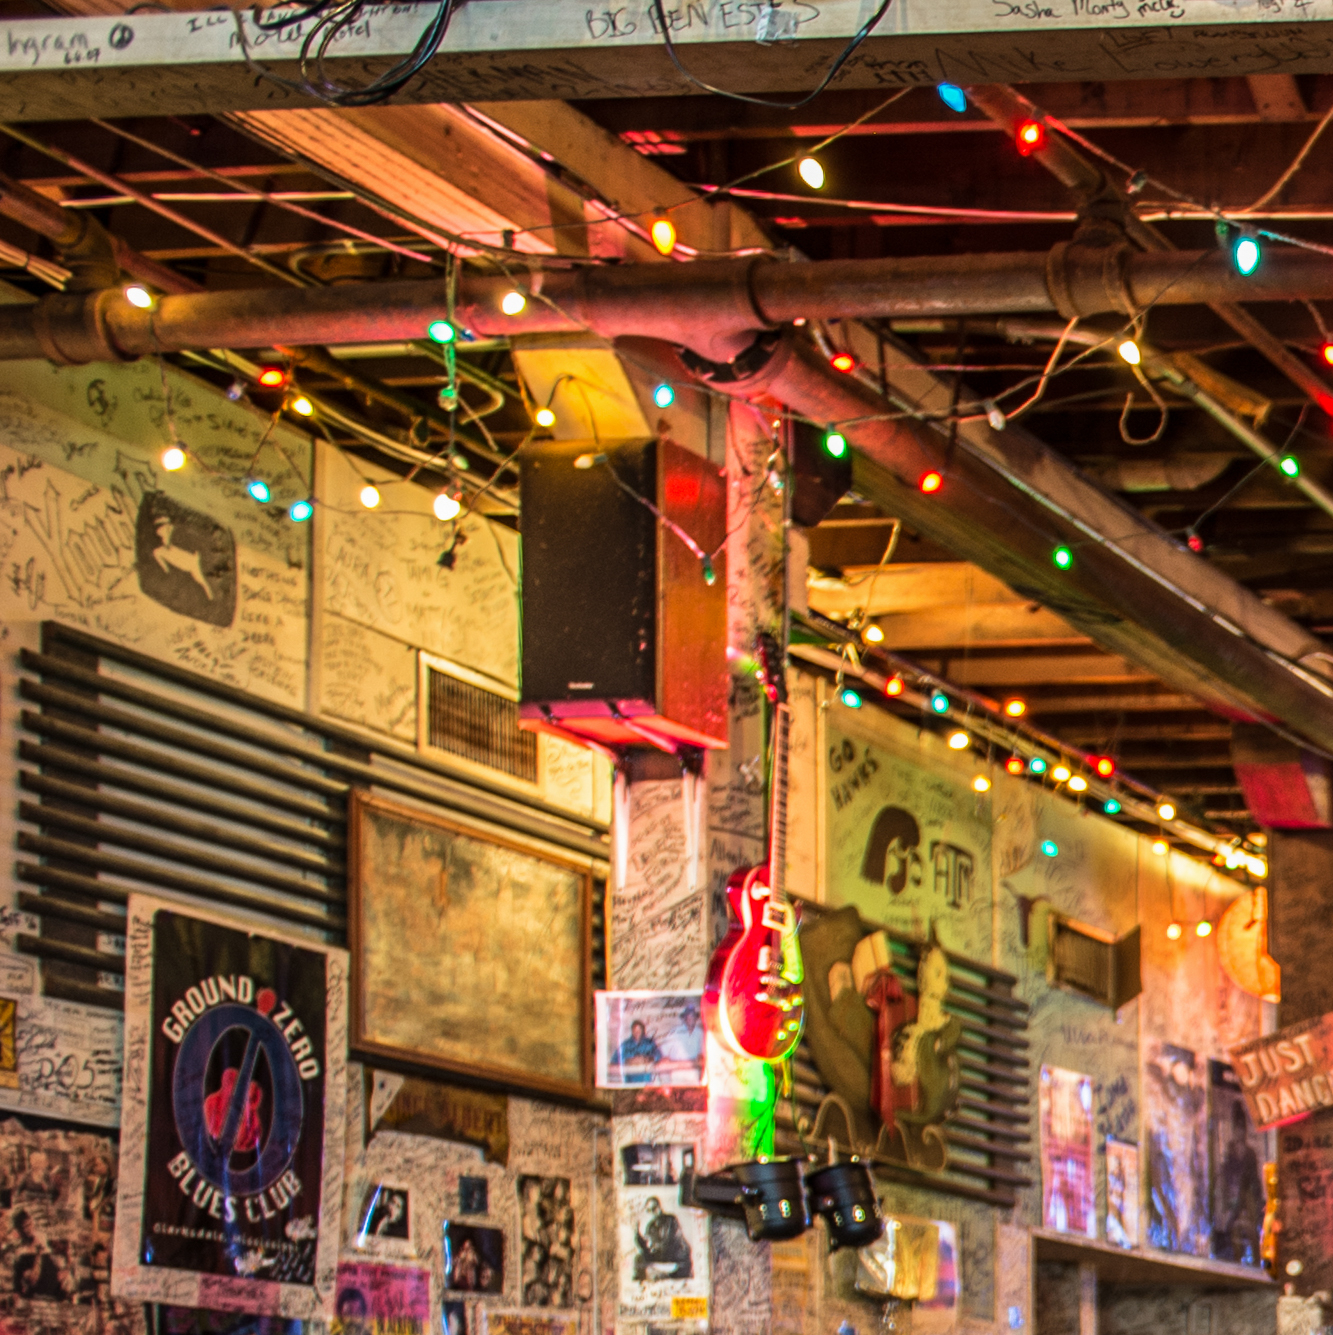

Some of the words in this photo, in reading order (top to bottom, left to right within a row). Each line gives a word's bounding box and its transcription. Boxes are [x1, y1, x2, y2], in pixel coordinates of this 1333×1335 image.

[827, 737, 856, 775] GO
[828, 747, 883, 812] HAWKS
[160, 974, 255, 1045] GROUND
[272, 1000, 322, 1081] ZERO
[1239, 1032, 1317, 1088] JUST
[166, 1150, 238, 1224] BLUES
[244, 1168, 303, 1224] CLUB
